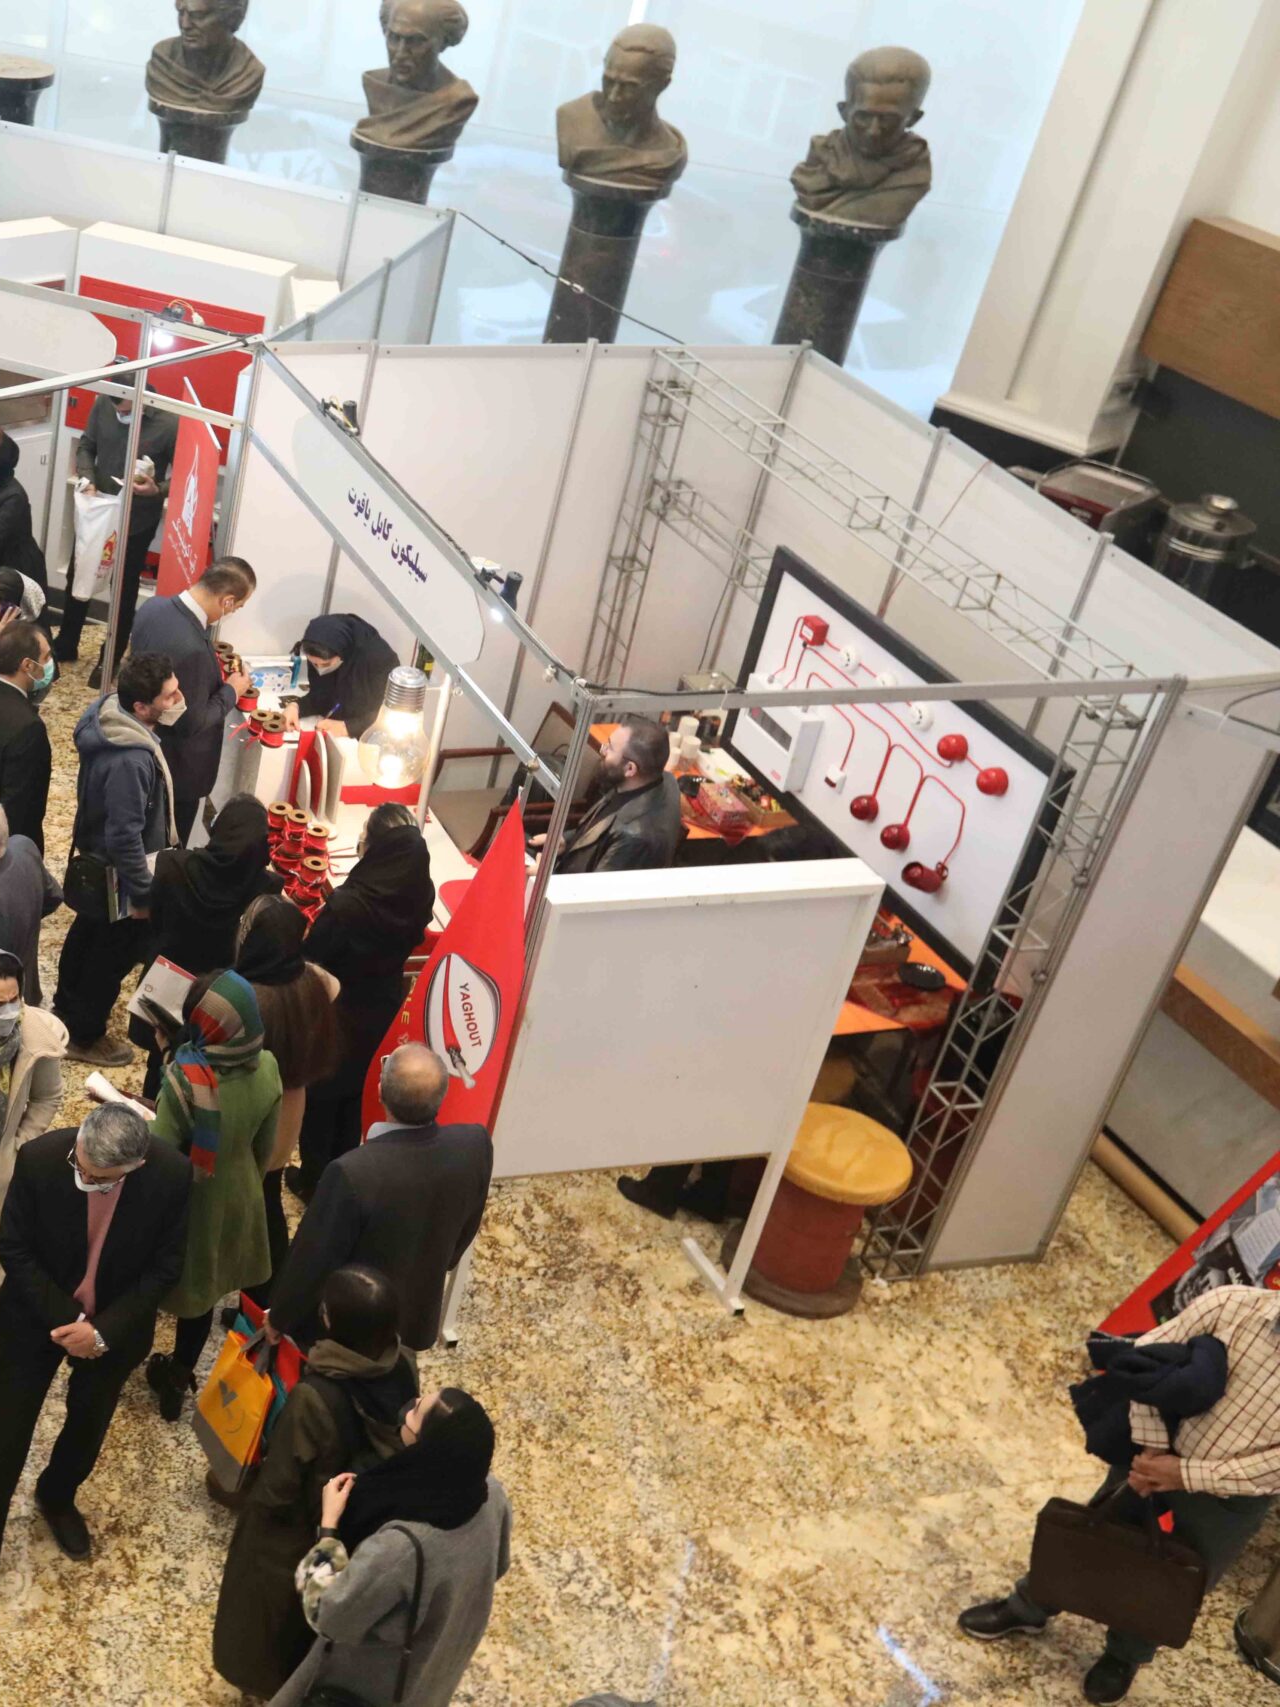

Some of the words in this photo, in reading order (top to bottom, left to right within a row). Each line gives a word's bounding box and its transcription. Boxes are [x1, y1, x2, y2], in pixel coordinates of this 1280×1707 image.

[348, 487, 371, 527] یاقوت
[371, 511, 393, 541] کابل
[391, 538, 428, 583] سیلیکون
[459, 982, 483, 1048] YAGHOUT
